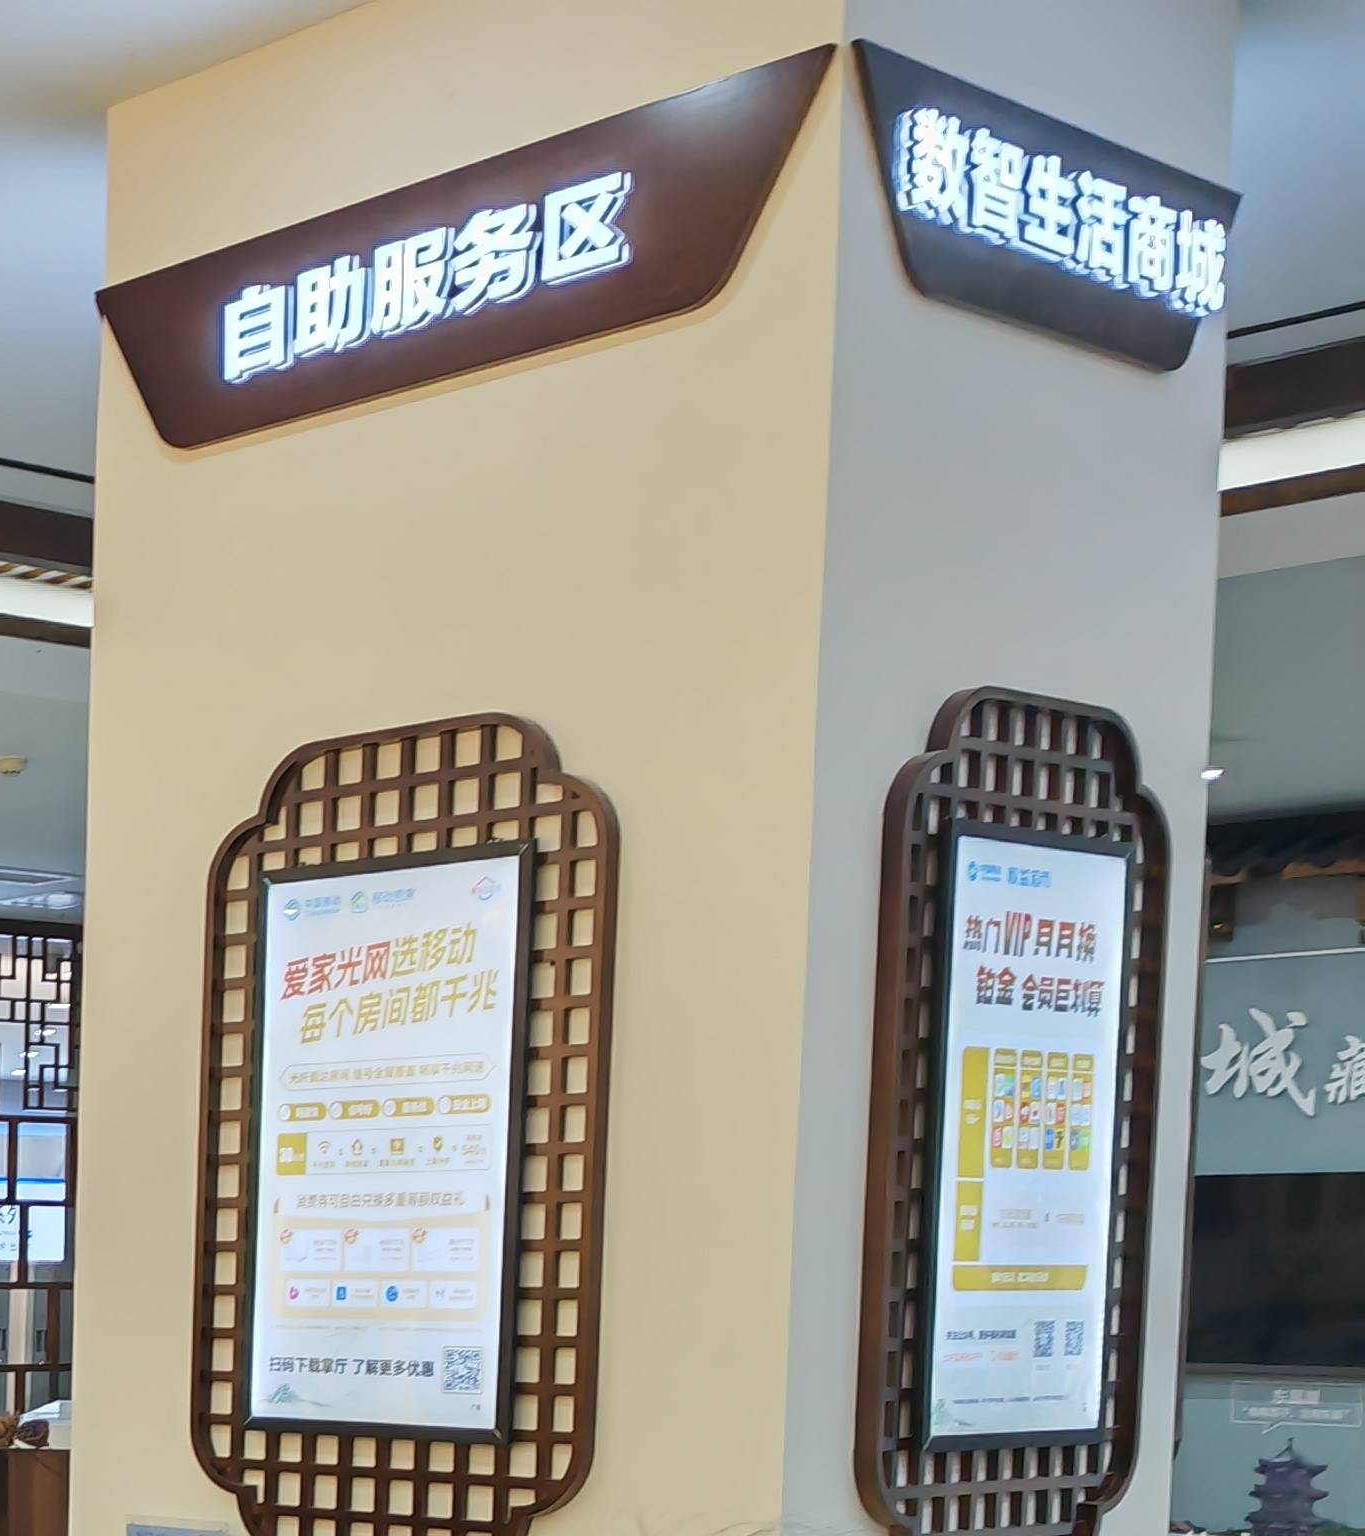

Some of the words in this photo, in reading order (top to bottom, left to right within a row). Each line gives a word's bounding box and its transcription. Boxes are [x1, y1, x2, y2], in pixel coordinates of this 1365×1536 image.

[220, 170, 633, 385] 自助服务区
[895, 106, 1226, 317] 数智生活商城
[281, 922, 477, 1000] 爱家光网选移动
[300, 968, 499, 1044] 每个房间都千兆
